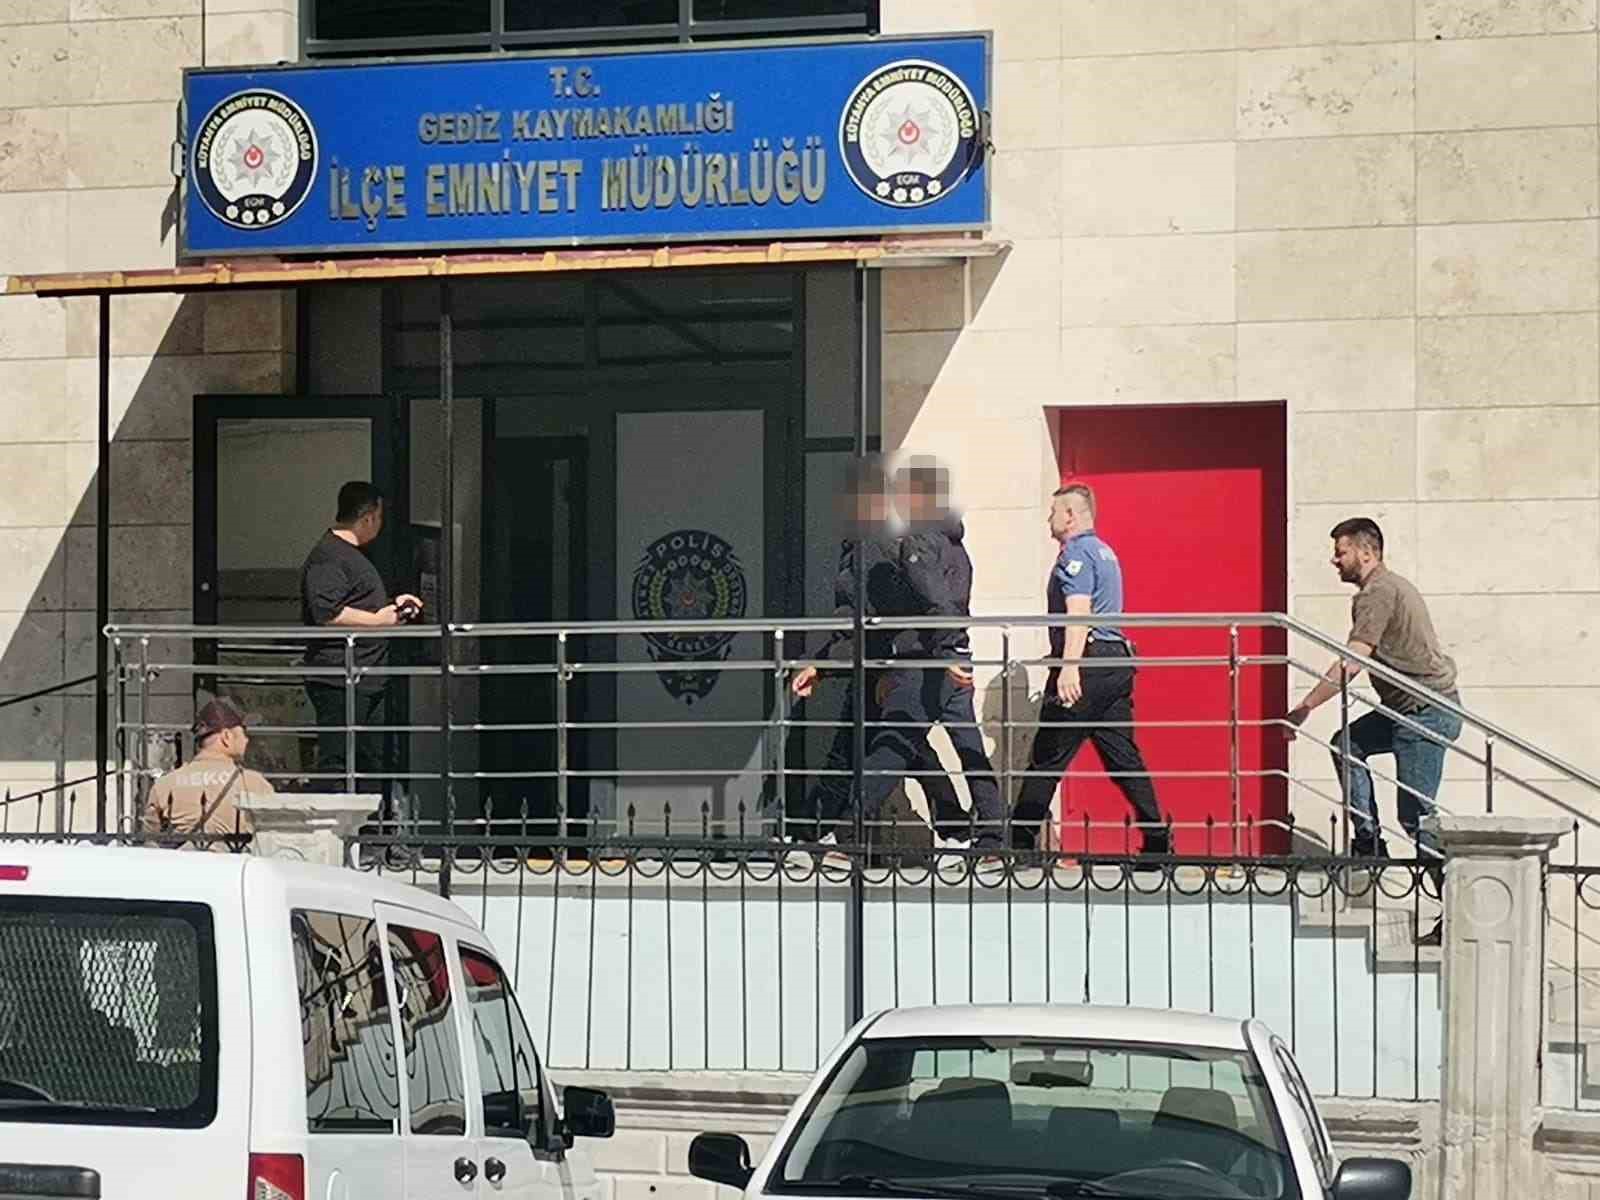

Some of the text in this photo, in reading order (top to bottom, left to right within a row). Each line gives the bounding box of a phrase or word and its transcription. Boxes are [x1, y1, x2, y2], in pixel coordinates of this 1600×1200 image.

[549, 66, 602, 98] T.C.
[418, 92, 734, 143] GEDİZ KAYMAKAMLIĞI
[329, 135, 828, 232] İLÇE EMNİYET MÜDÜRLÜĞÜ
